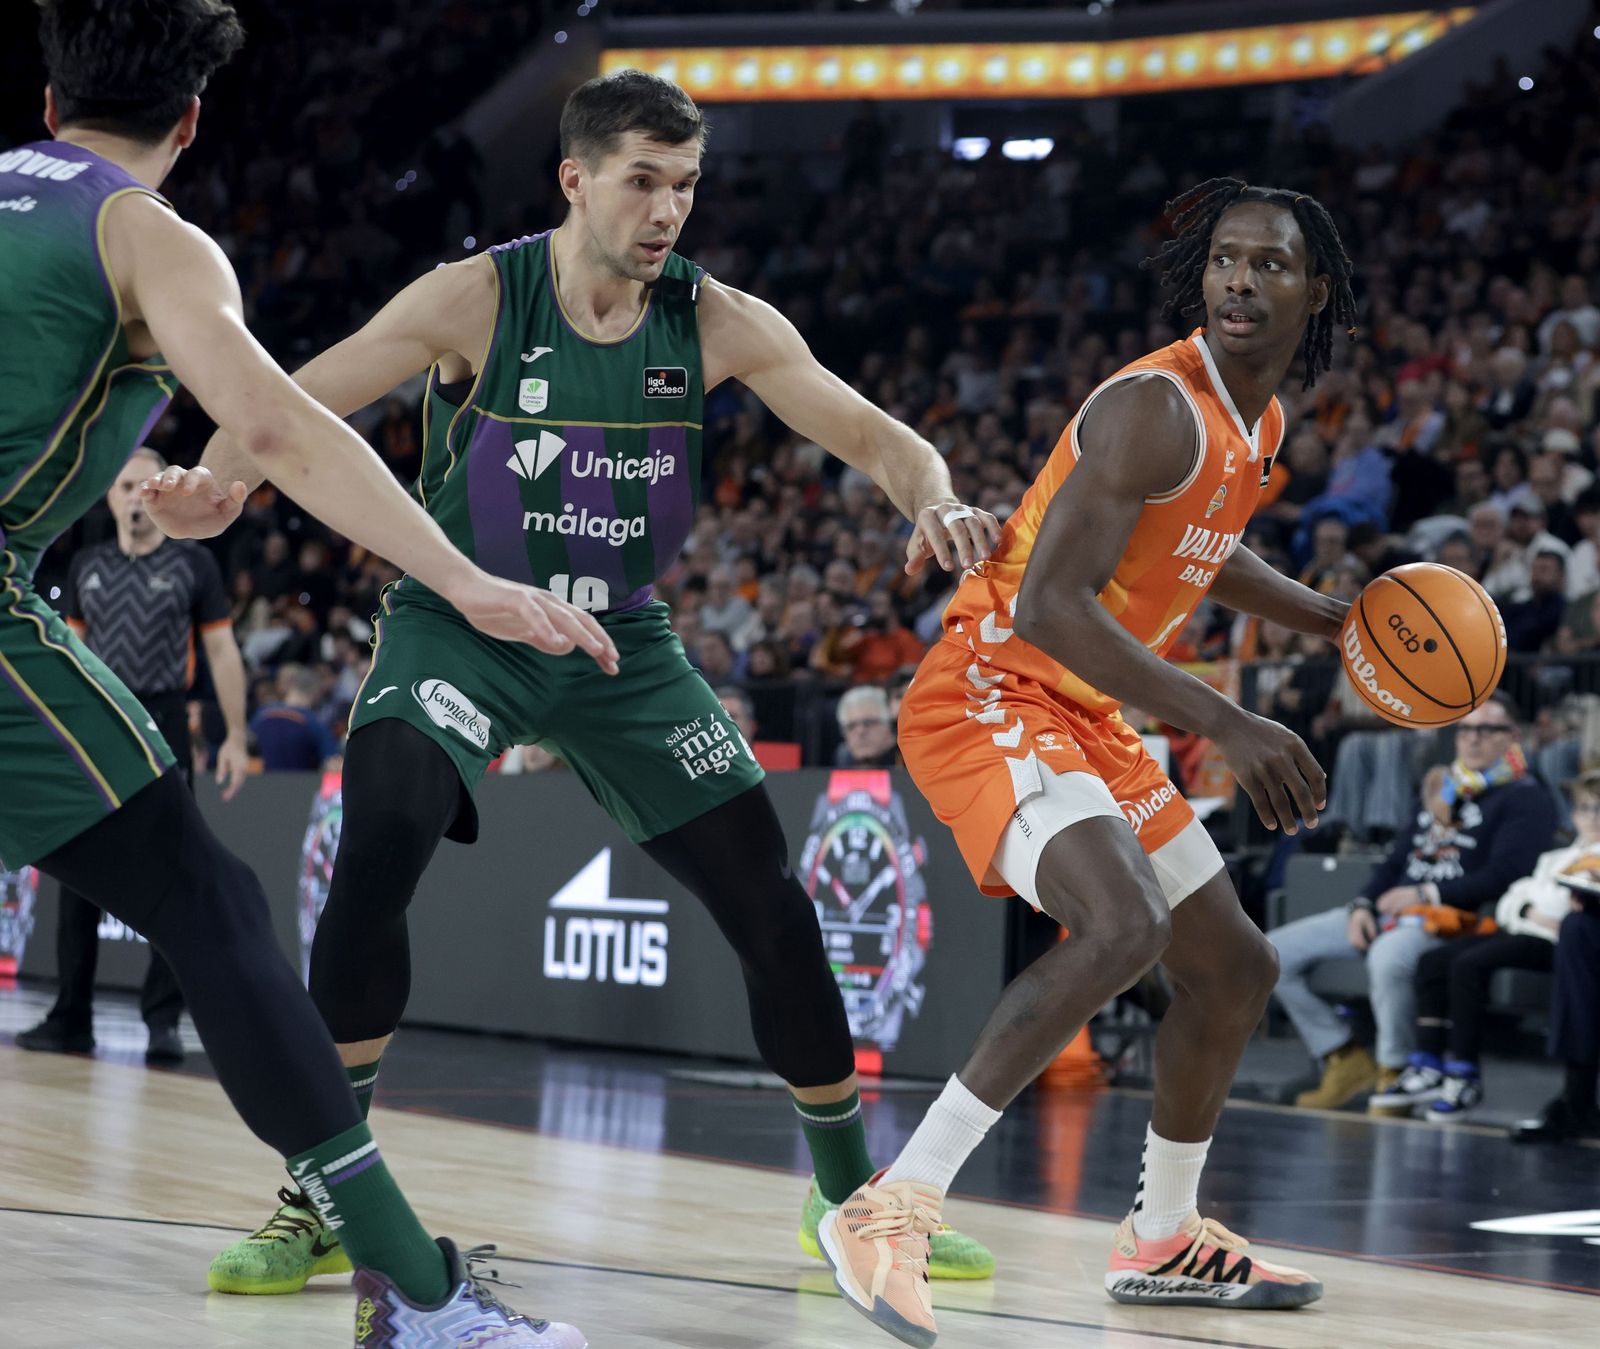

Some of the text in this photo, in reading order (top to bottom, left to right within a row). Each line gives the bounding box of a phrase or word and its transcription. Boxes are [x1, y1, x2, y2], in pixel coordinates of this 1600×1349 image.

[0, 149, 93, 181] OVIĆ
[647, 377, 665, 387] liga
[647, 386, 684, 394] endesa
[570, 449, 676, 486] Unicaja
[1171, 523, 1246, 564] VALEN
[1177, 564, 1215, 588] BAS
[1388, 613, 1421, 654] acb
[1343, 620, 1413, 718] Wilson
[422, 682, 488, 746] famadesa
[665, 717, 702, 747] sabor
[672, 747, 684, 758] a
[1122, 779, 1178, 832] Midea
[1013, 810, 1033, 841] TECHF
[543, 915, 669, 987] LOTUS
[301, 1172, 346, 1231] UNICAJA
